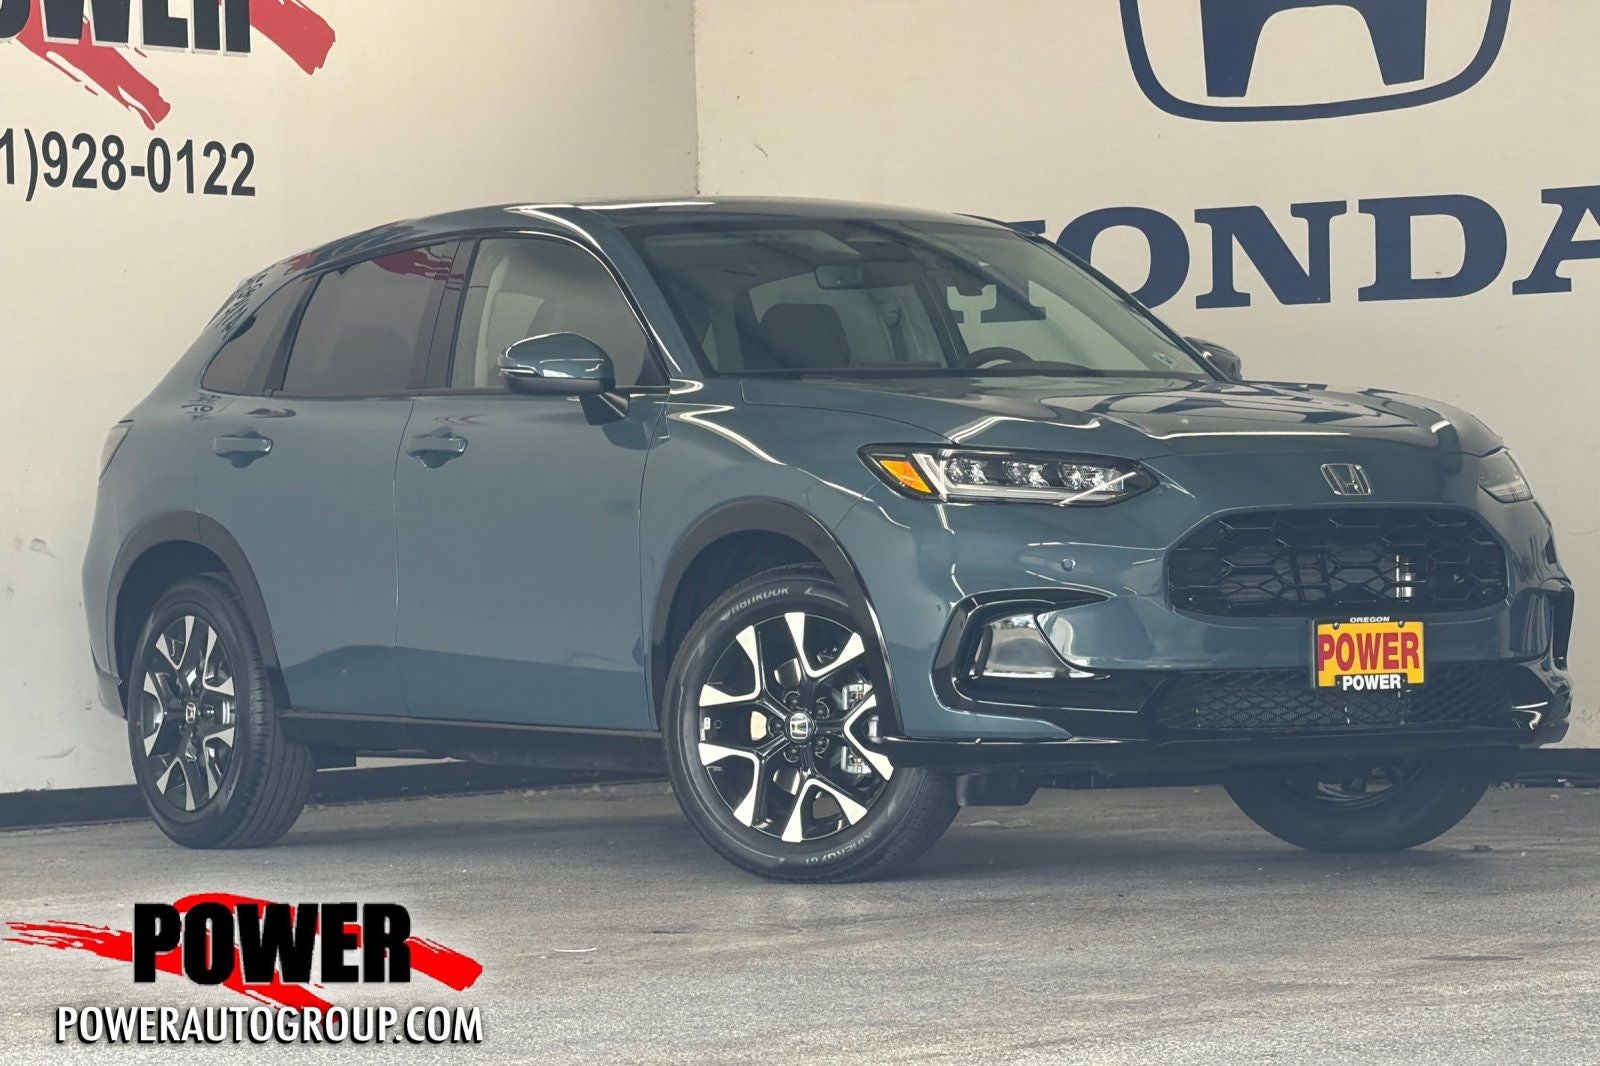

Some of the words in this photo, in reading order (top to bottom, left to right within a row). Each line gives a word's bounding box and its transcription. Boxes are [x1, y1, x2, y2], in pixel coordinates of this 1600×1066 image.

[1349, 615, 1391, 624] OREGON
[1318, 631, 1420, 672] POWER
[1342, 674, 1402, 691] POWER
